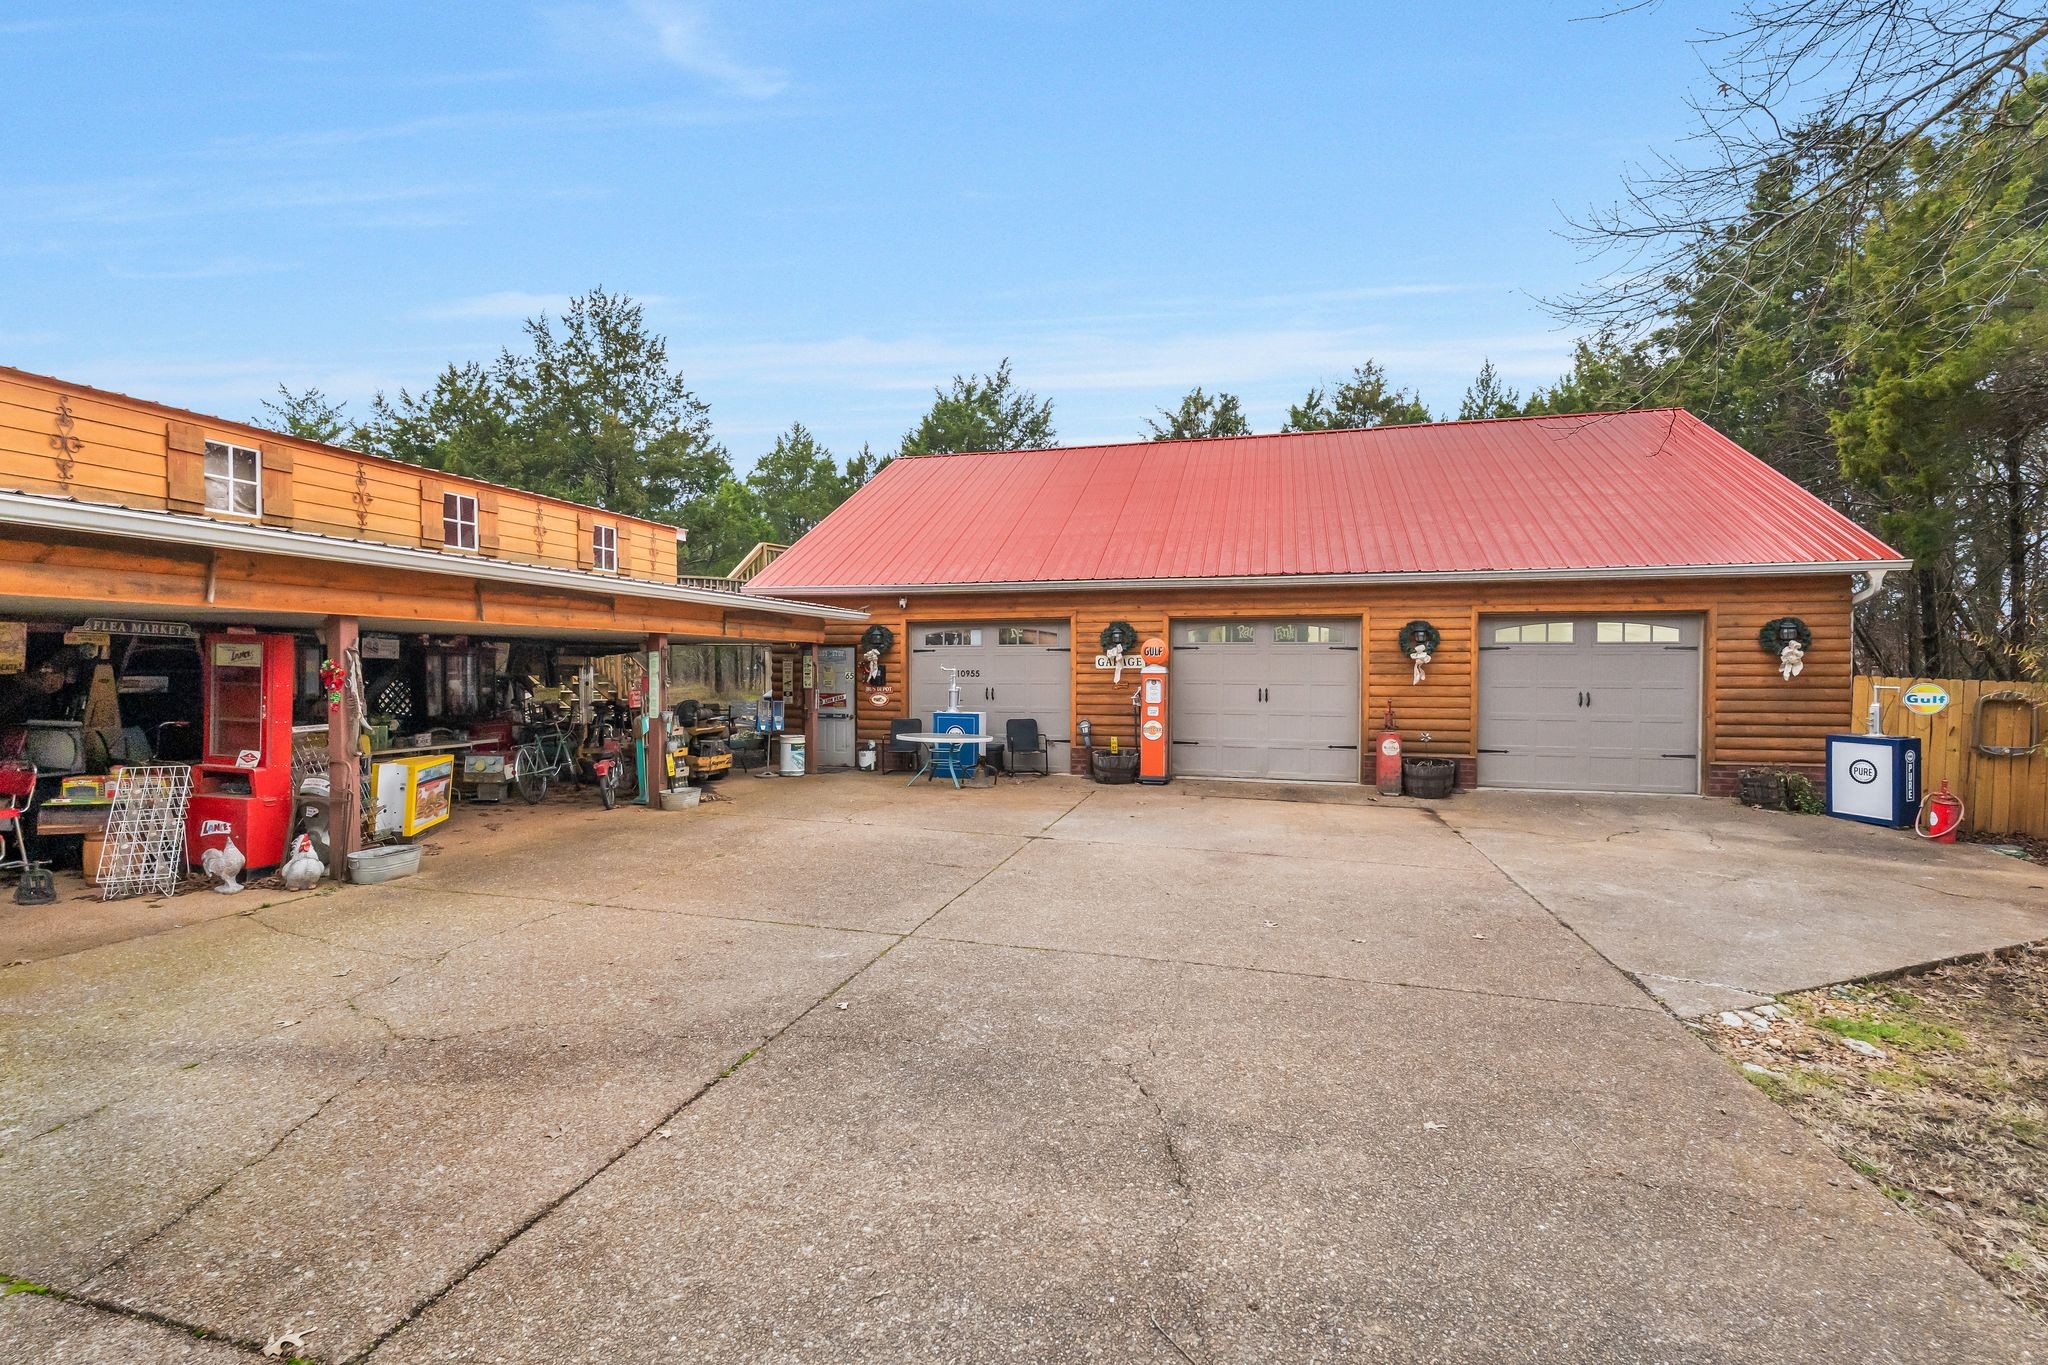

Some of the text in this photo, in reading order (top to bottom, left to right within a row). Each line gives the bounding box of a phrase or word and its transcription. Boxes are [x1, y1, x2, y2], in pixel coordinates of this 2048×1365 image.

[93, 620, 184, 635] FLEA MARKET
[1144, 646, 1163, 656] GULF
[1097, 657, 1142, 667] GAGE
[845, 672, 854, 680] 65
[957, 670, 980, 678] 10955
[1906, 694, 1946, 704] Gulf
[1853, 766, 1873, 777] PURE
